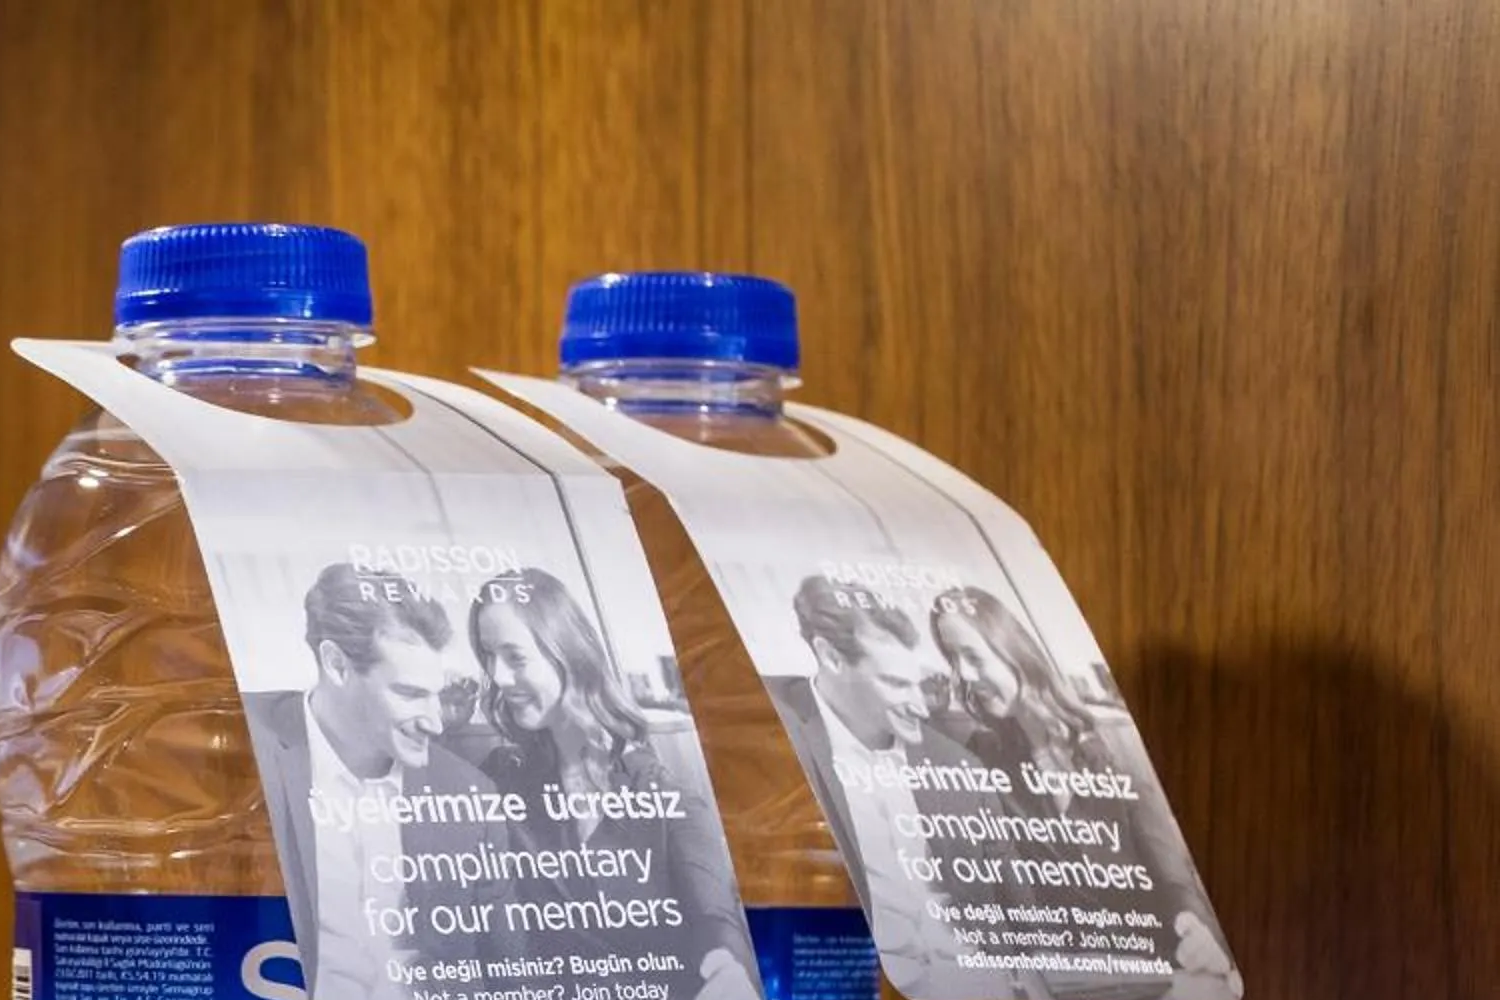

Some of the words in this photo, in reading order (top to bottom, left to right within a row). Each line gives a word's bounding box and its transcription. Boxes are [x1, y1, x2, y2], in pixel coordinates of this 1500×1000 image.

[1020, 762, 1139, 800] ücretsiz
[307, 786, 527, 832] üyelerimize
[541, 783, 686, 821] ücretsiz
[894, 809, 1122, 852] complimentary
[370, 843, 652, 888] complimentary
[897, 850, 943, 883] for
[953, 856, 1003, 885] our
[1011, 855, 1153, 891] members
[363, 897, 419, 936] for
[431, 902, 494, 935] our
[505, 891, 683, 932] members
[964, 903, 1007, 926] değil
[1008, 904, 1069, 924] misiniz?
[1071, 907, 1123, 928] Bugün
[1124, 909, 1163, 929] olun.
[952, 927, 987, 945] Not
[989, 931, 1001, 945] a
[1003, 929, 1074, 948] member?
[1079, 930, 1111, 949] Join
[1113, 932, 1156, 953] today
[432, 959, 483, 983] değil
[487, 956, 564, 979] misiniz?
[569, 953, 633, 978] Bugün
[637, 952, 685, 972] olun.
[957, 952, 1173, 976] radissonhotels.com/rewards
